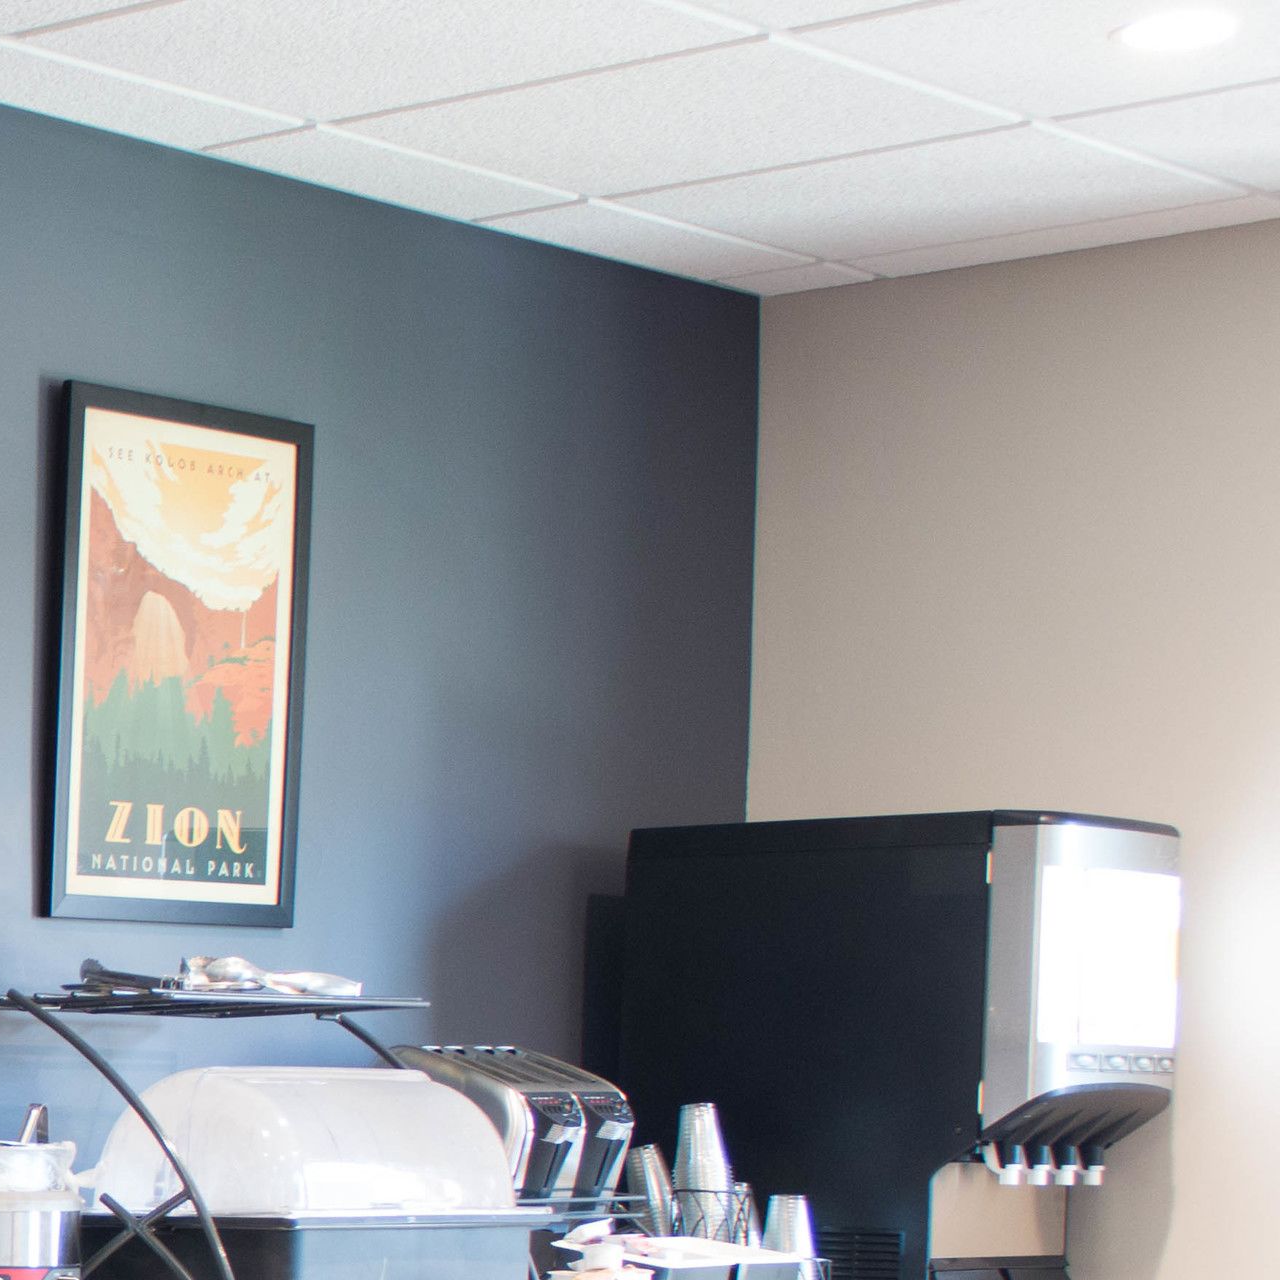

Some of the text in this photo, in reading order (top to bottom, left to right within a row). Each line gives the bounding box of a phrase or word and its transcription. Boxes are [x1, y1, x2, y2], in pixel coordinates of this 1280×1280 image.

[108, 446, 271, 482] SEE KOLOB ARCH AT
[104, 799, 248, 855] ZION
[90, 853, 255, 879] NATIONAL PARK
